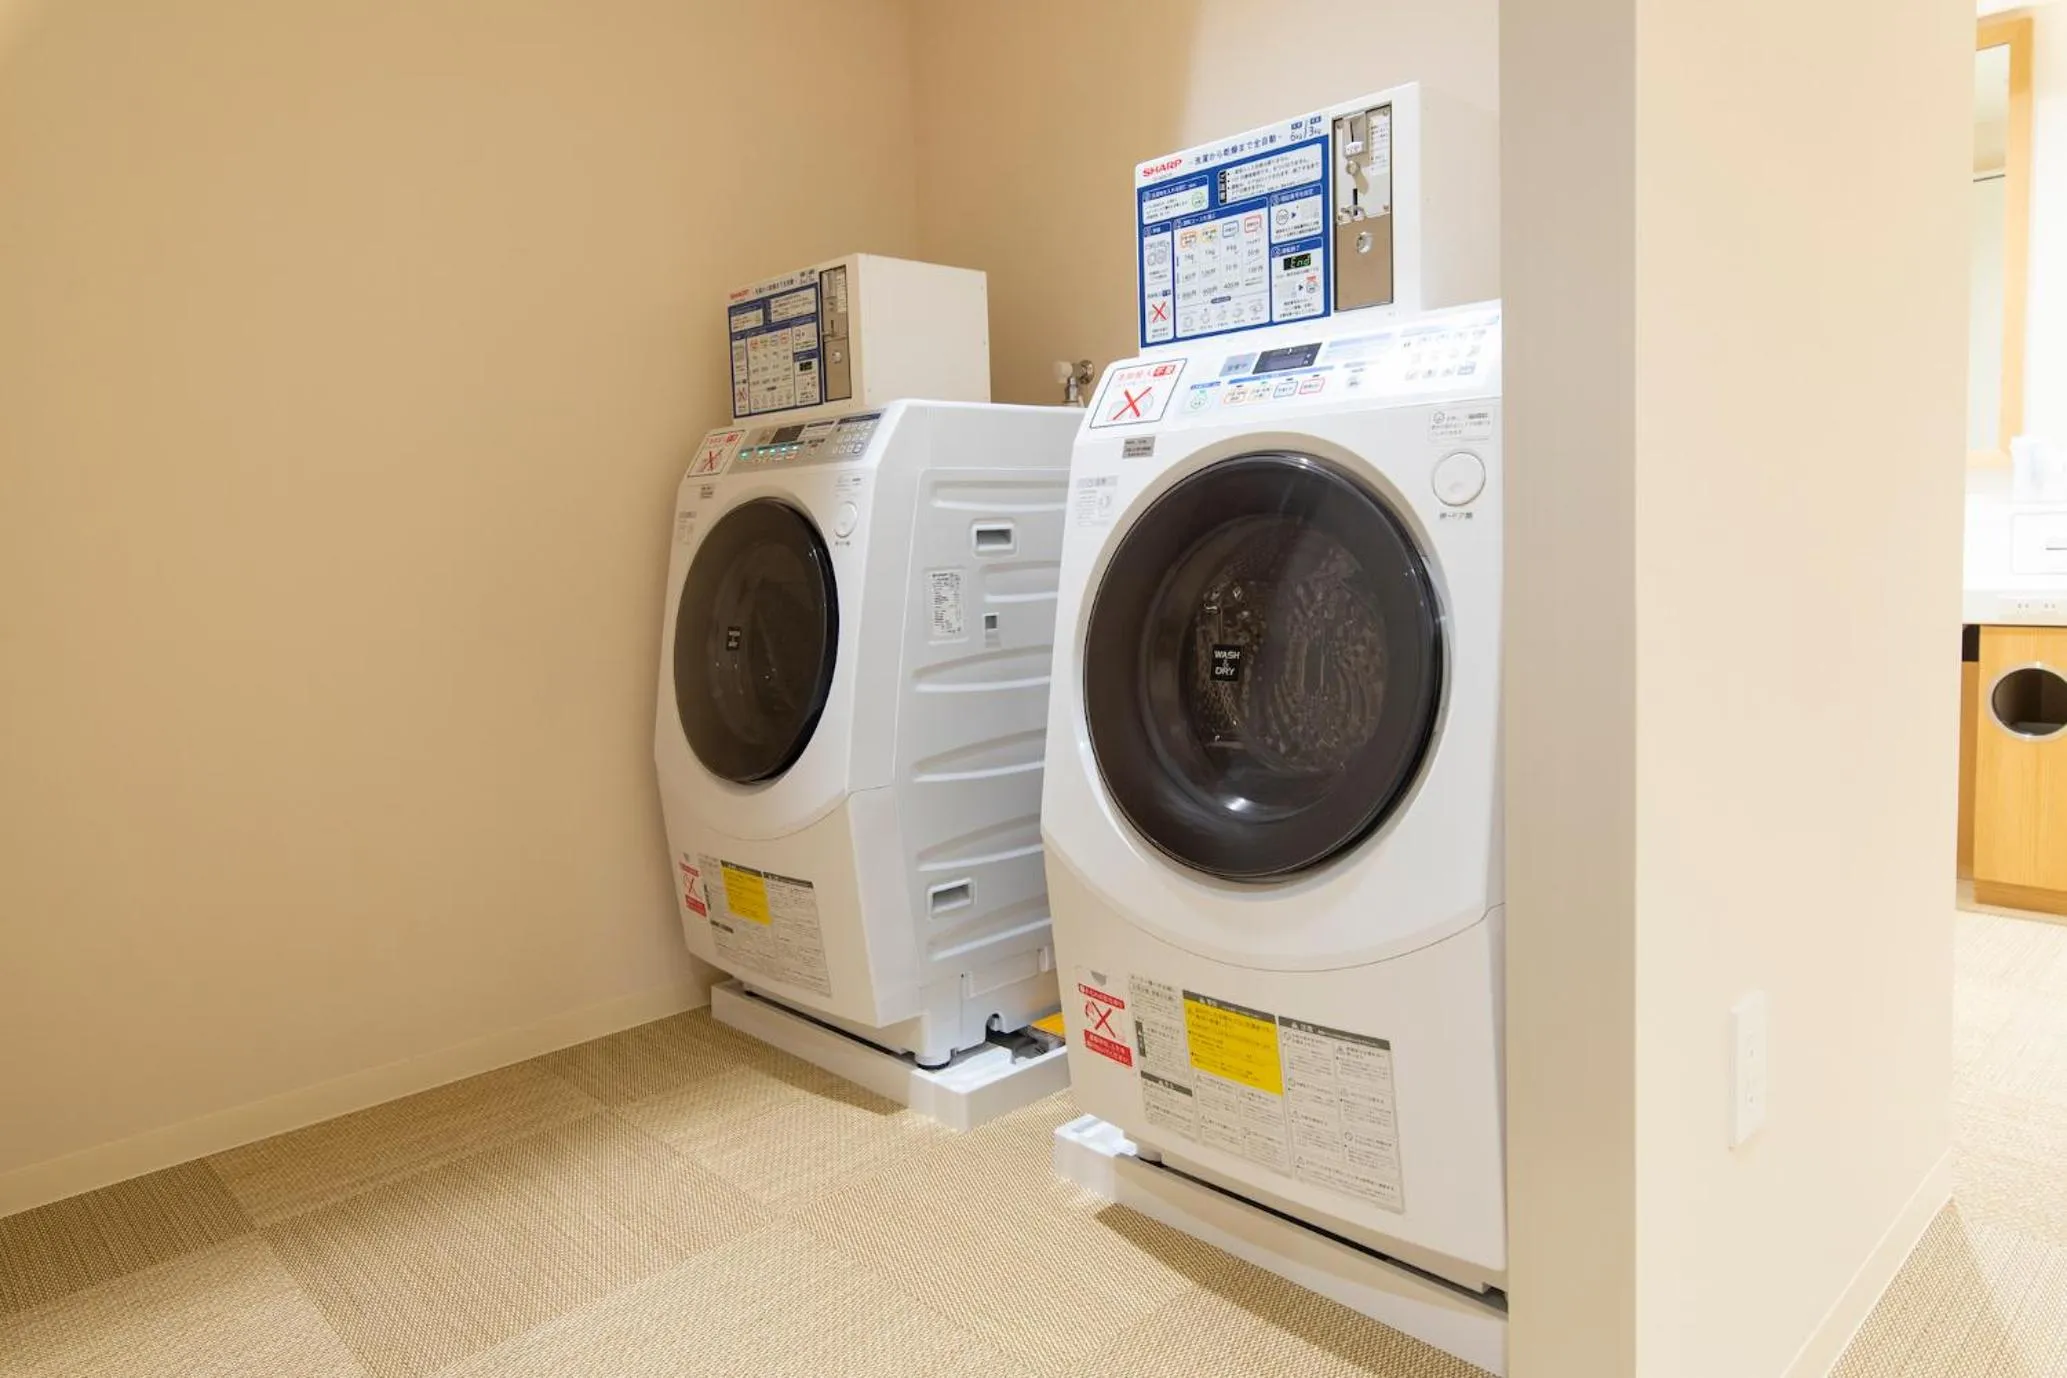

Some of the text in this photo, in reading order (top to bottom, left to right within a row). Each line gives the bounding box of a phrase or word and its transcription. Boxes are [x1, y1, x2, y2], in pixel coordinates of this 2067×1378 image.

[1142, 158, 1183, 177] SHARP
[1214, 650, 1240, 659] WASH
[1215, 666, 1235, 675] DRY
